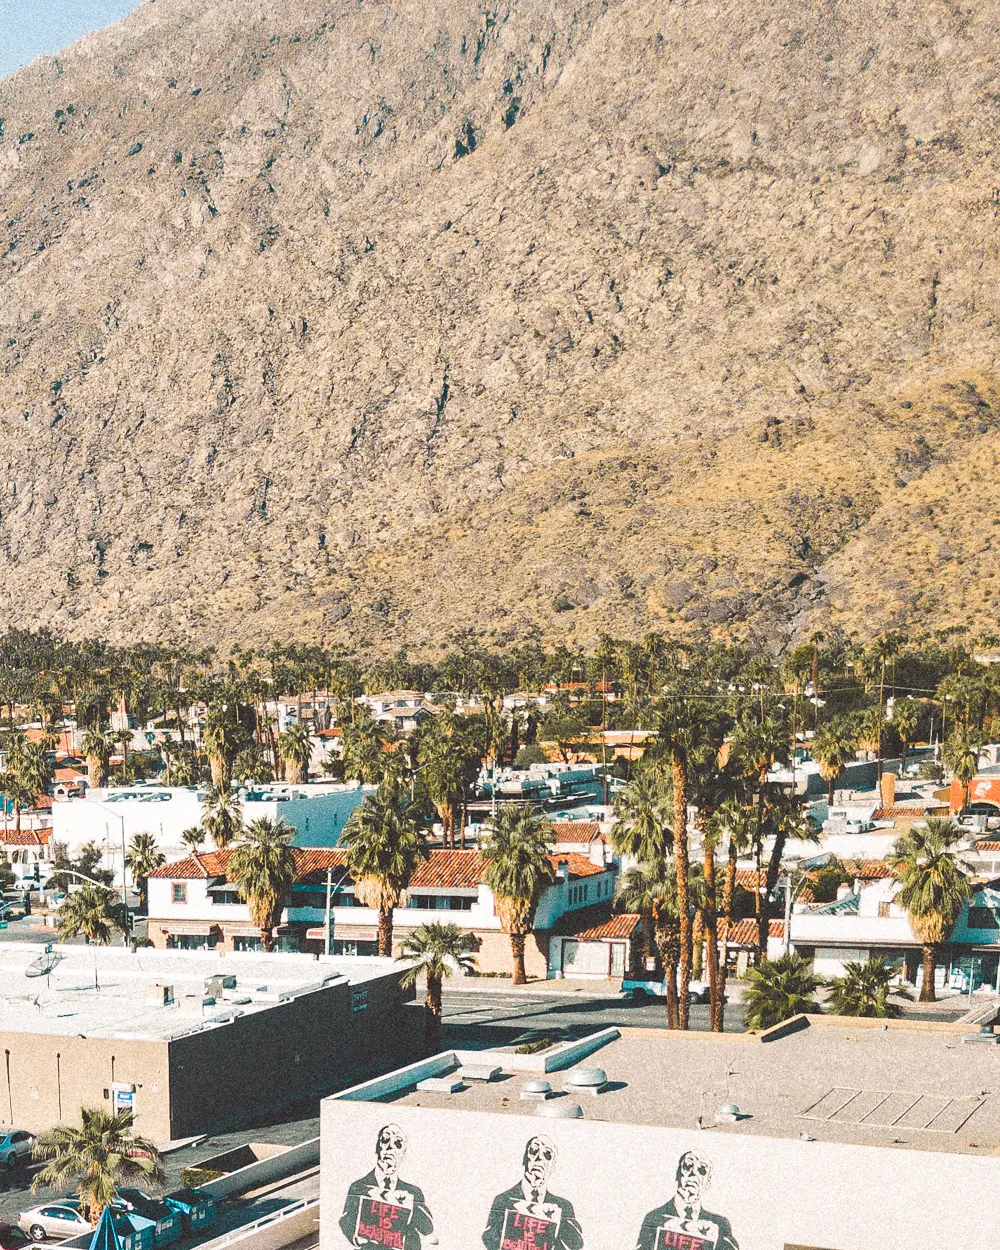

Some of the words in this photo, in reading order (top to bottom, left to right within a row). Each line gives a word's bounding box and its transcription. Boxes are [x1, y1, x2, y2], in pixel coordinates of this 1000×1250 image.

[370, 1201, 402, 1220] LIFE
[379, 1217, 393, 1229] IS
[514, 1213, 550, 1234] LIFE
[358, 1222, 403, 1250] BEAUTIFUL
[523, 1230, 536, 1242] IS
